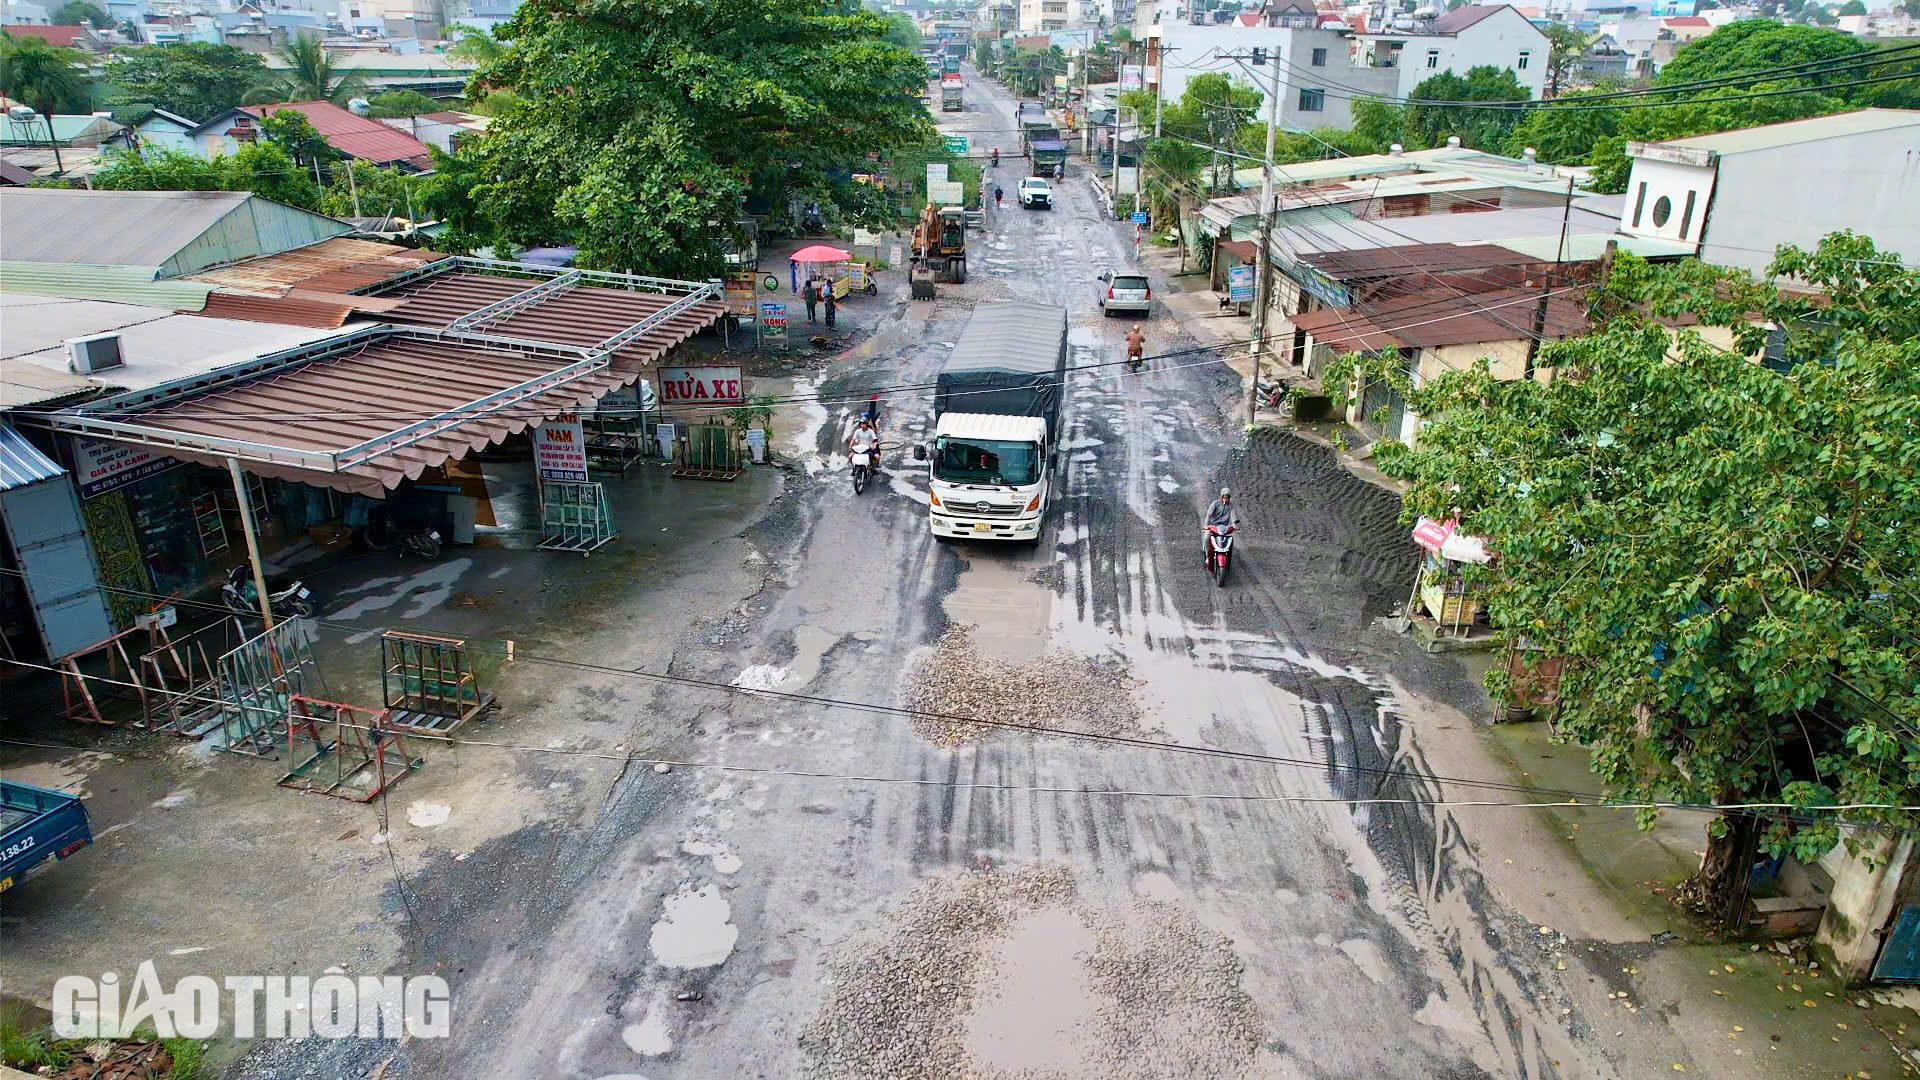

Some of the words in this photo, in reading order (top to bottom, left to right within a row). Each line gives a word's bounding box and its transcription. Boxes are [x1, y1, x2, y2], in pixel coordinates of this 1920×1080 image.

[663, 372, 708, 399] RỬA
[712, 380, 739, 399] XE
[545, 429, 573, 442] NAM
